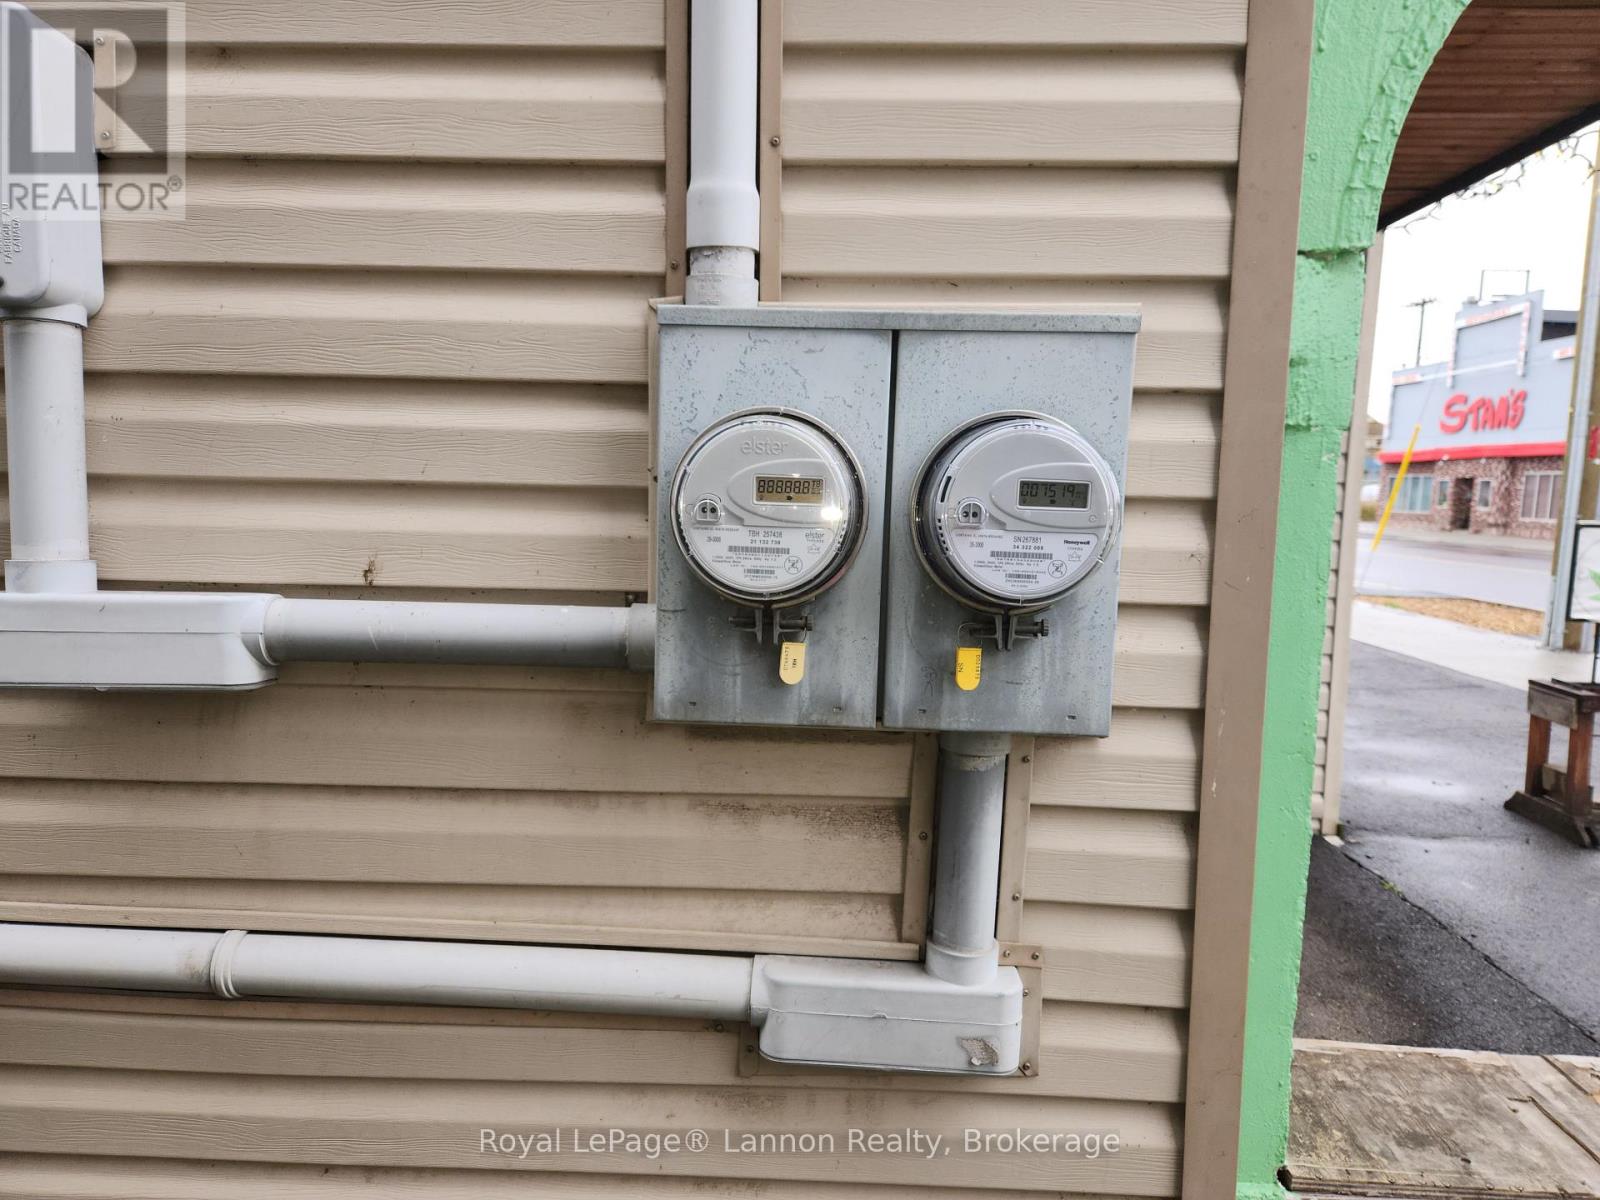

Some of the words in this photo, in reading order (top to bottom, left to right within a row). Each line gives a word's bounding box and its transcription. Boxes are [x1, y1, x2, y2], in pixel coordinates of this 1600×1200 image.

[741, 436, 788, 456] elster
[758, 479, 810, 494] 888888
[805, 530, 825, 539] elster
